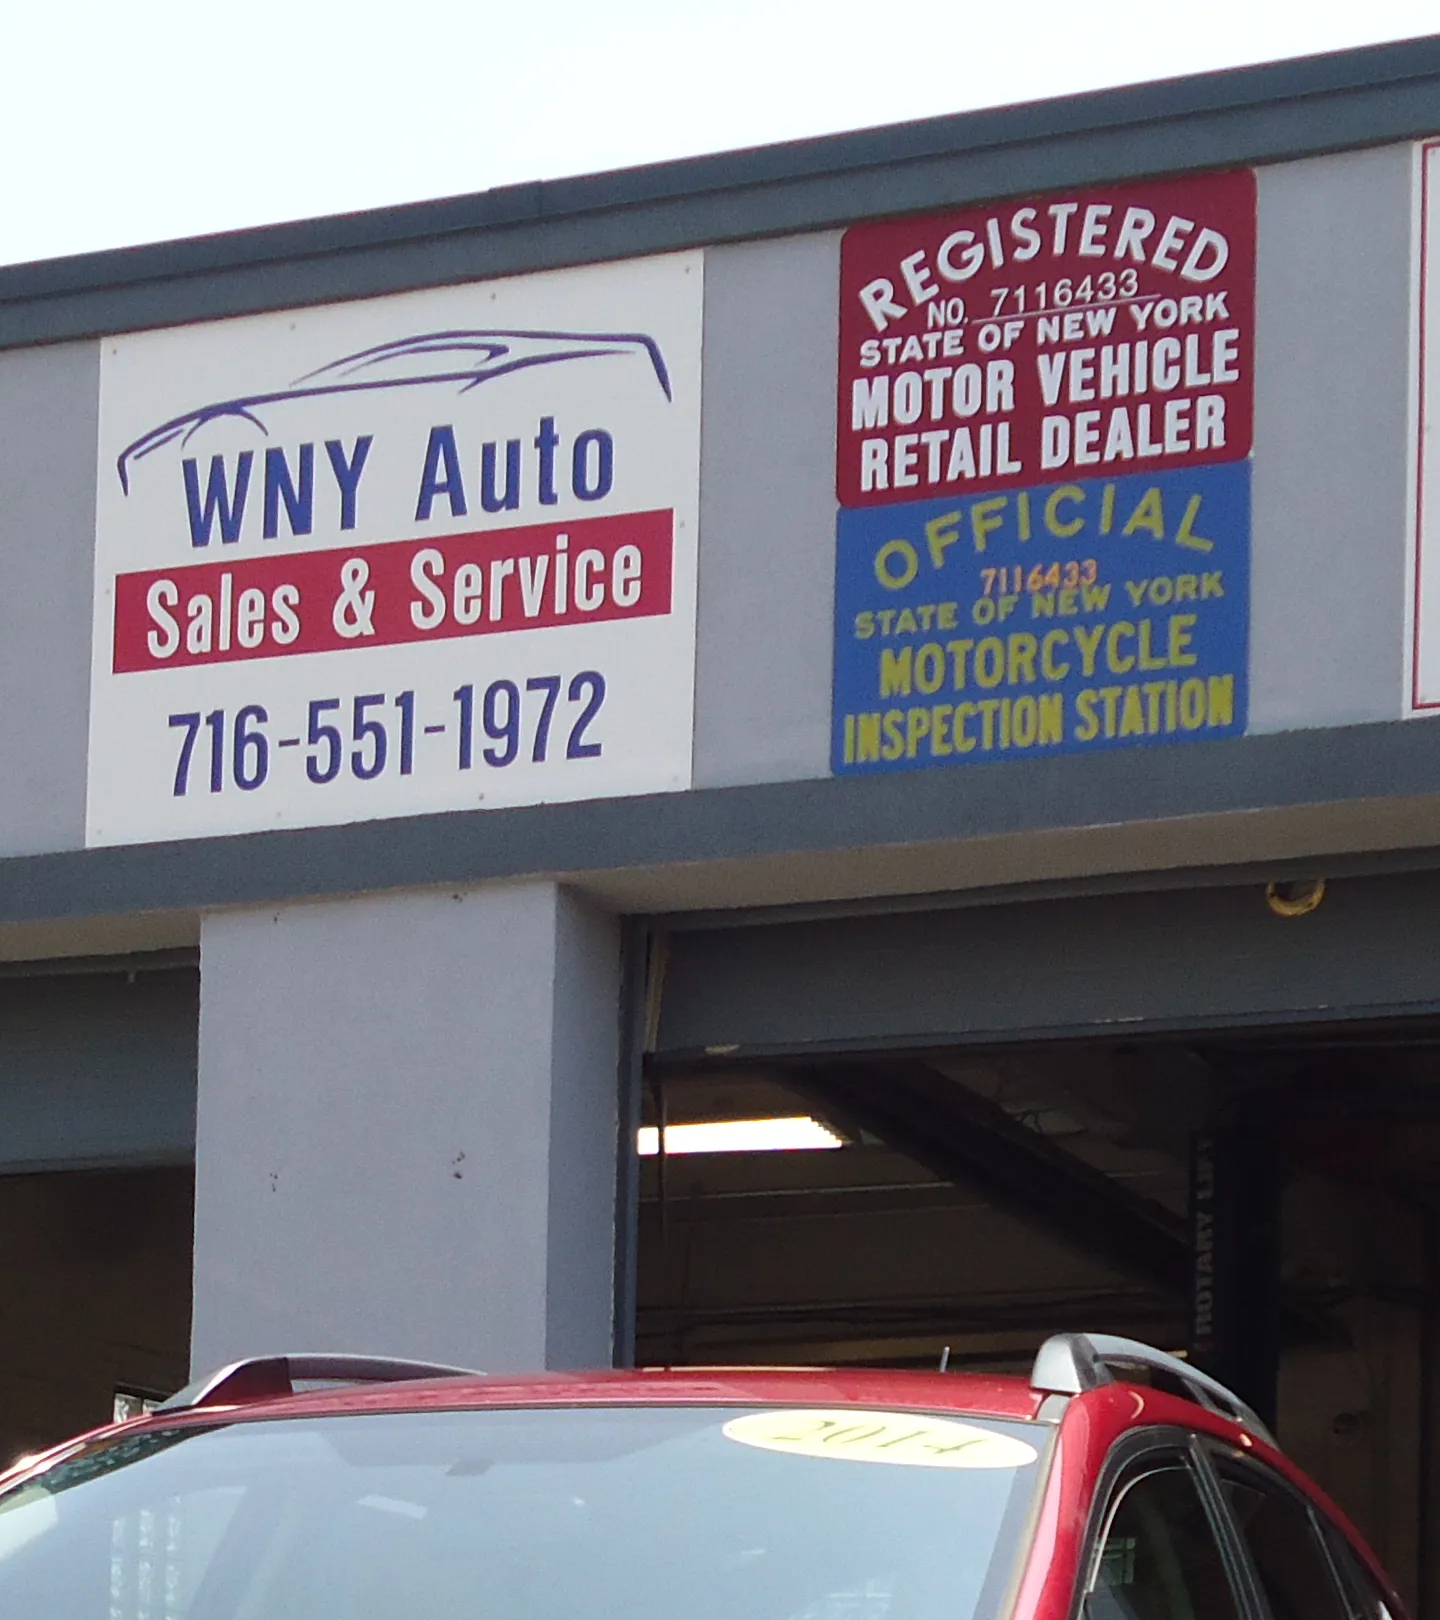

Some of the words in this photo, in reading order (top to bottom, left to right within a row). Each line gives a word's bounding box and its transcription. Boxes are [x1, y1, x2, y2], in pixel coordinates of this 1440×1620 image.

[858, 201, 1229, 332] REGISTERED
[926, 298, 969, 328] NO.
[990, 268, 1139, 317] 7116433
[859, 329, 964, 367] STATE
[978, 320, 1022, 353] OF
[1036, 308, 1115, 346] NEW
[1130, 290, 1230, 332] YORK
[851, 359, 1015, 431] MOTOR
[1036, 328, 1240, 407] VEHICLE
[181, 434, 375, 549] WNY
[414, 415, 614, 523] Auto
[860, 421, 1022, 493] RETAIL
[1040, 394, 1226, 470] DEALER
[874, 485, 1215, 589] OFFICIAL
[980, 558, 1099, 595] 7116433
[146, 579, 301, 660] Sales
[331, 557, 377, 639] &
[410, 533, 643, 631] Service
[854, 600, 959, 639] STATE
[972, 594, 1017, 626] OF
[1033, 584, 1113, 618] NEW
[1125, 570, 1225, 608] YORK
[879, 614, 1198, 699] MOTORCYCLE
[167, 670, 607, 798] 716-551-1972
[843, 693, 1061, 763] INSPECTION
[1074, 673, 1235, 741] STATION
[1193, 1211, 1215, 1336] ROTARY
[772, 1419, 988, 1455] 2014
